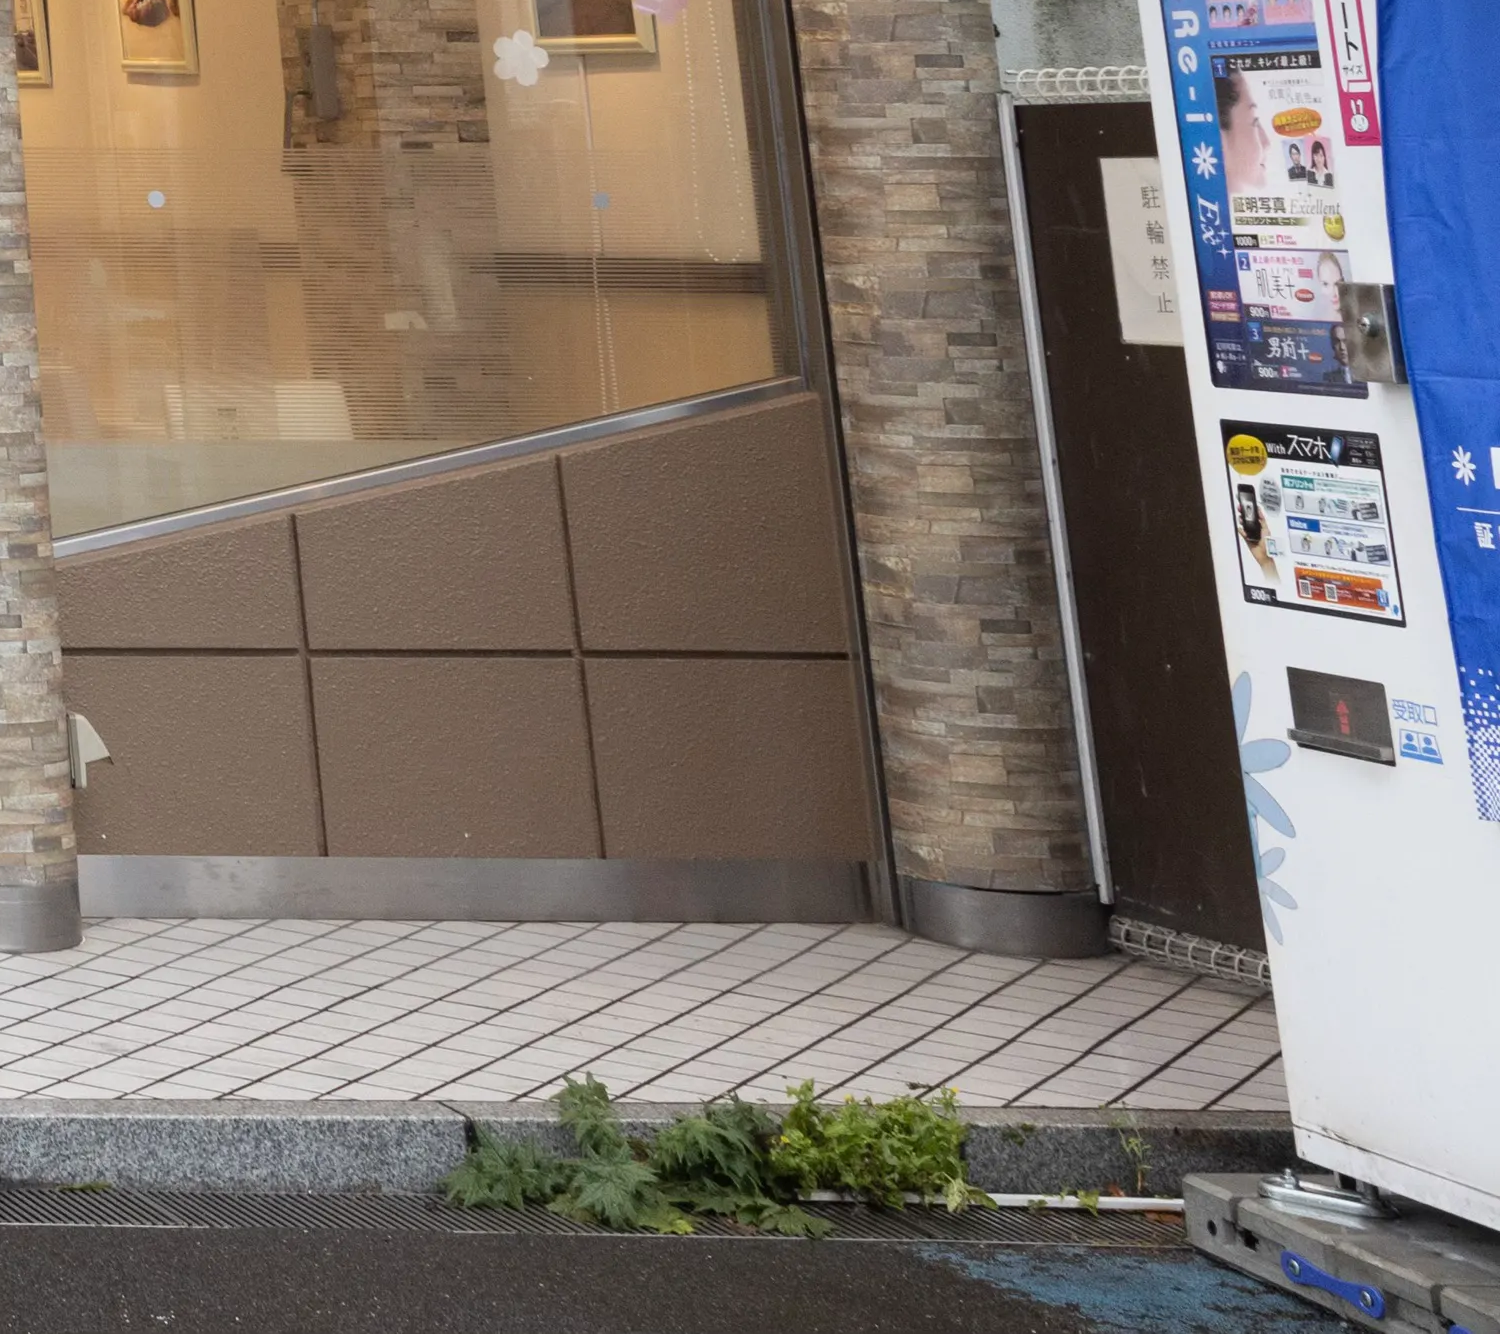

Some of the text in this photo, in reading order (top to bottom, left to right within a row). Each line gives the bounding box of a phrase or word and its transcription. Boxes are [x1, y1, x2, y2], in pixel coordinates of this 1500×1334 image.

[1228, 54, 1313, 69] これが、キレイ最上級!
[1342, 64, 1364, 76] サイズ
[1232, 196, 1341, 216] 証明写真 Excellent
[1140, 184, 1175, 315] 駐輪禁止
[1250, 305, 1270, 319] 900円
[1258, 365, 1279, 379] 900円
[1265, 441, 1287, 456] With
[1286, 433, 1332, 461] スマホ
[1250, 588, 1272, 603] 900円
[1390, 698, 1438, 726] 受取口
